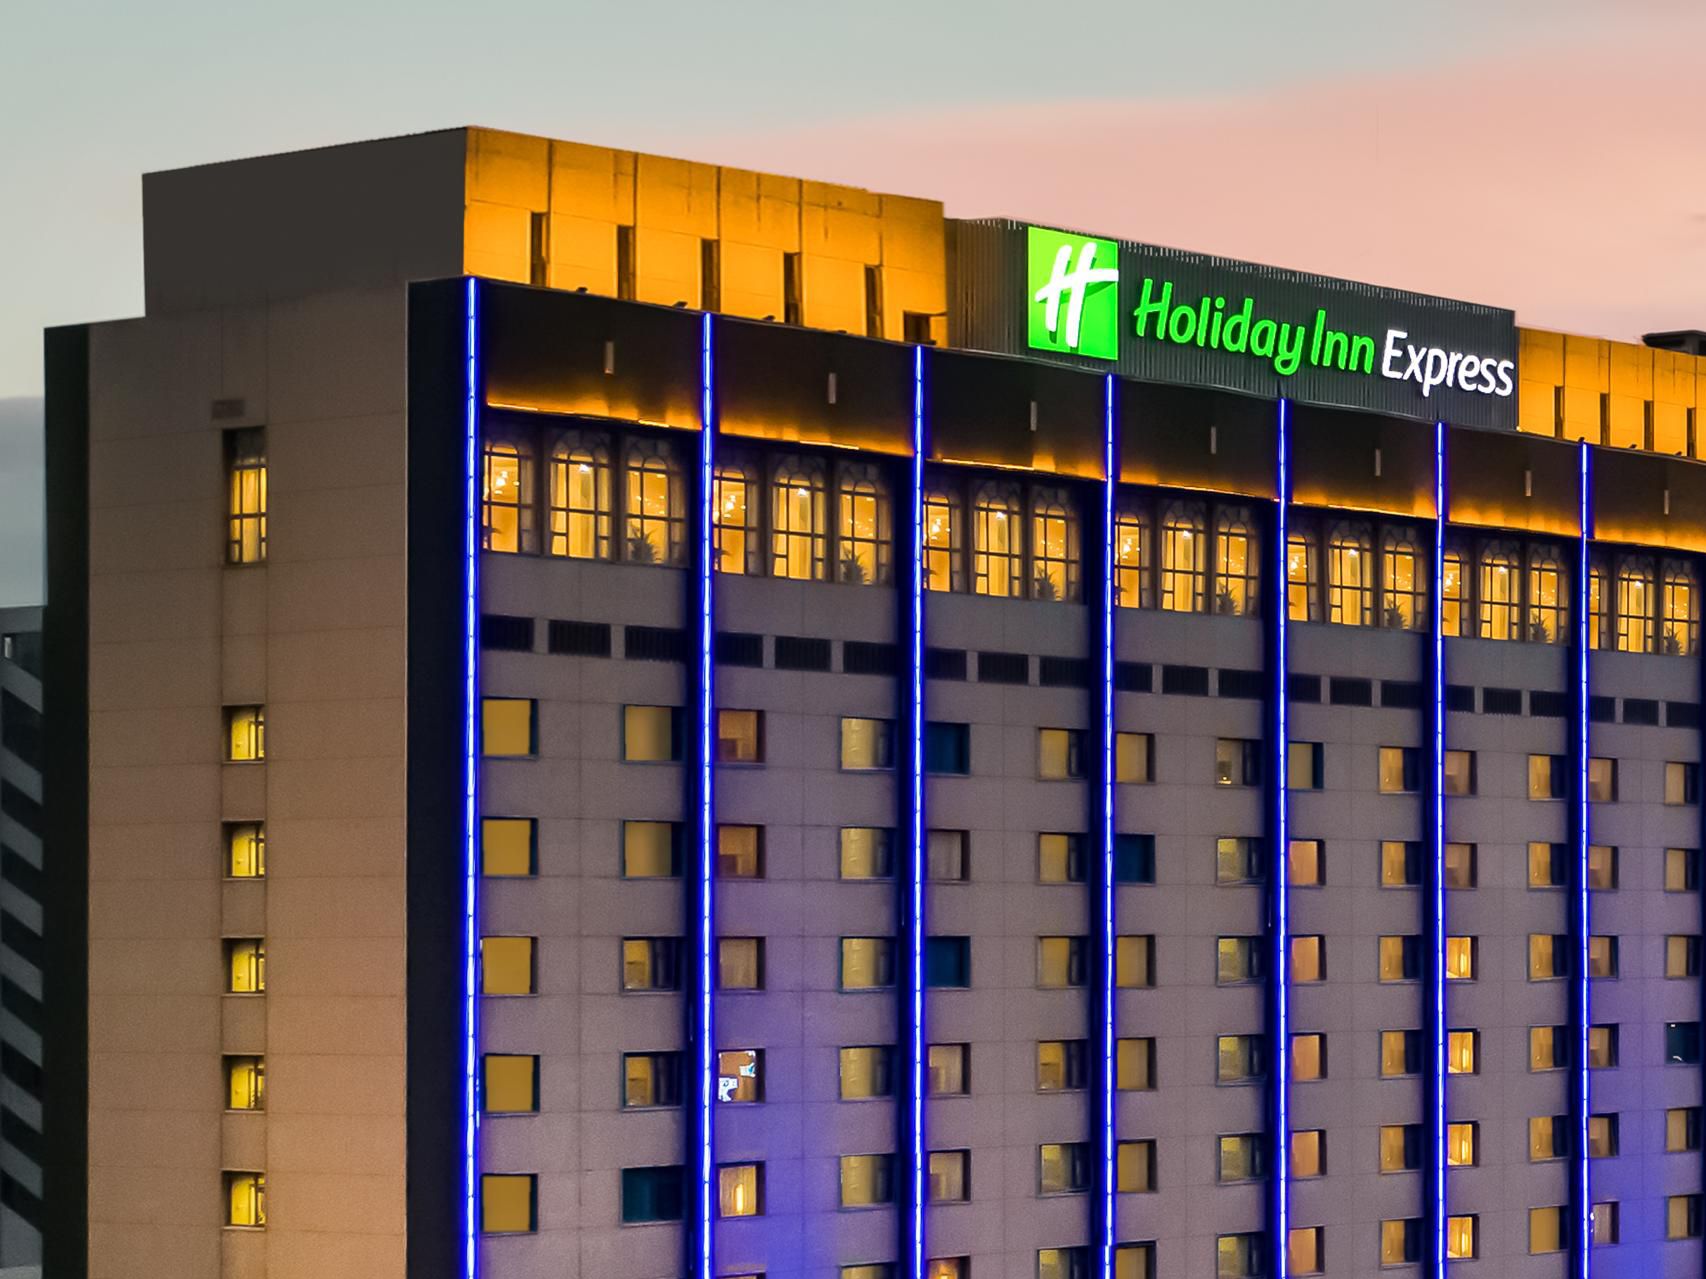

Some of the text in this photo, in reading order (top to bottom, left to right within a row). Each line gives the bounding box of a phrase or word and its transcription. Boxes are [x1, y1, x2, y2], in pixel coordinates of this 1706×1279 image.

[1132, 278, 1516, 398] Holiday Inn Express
